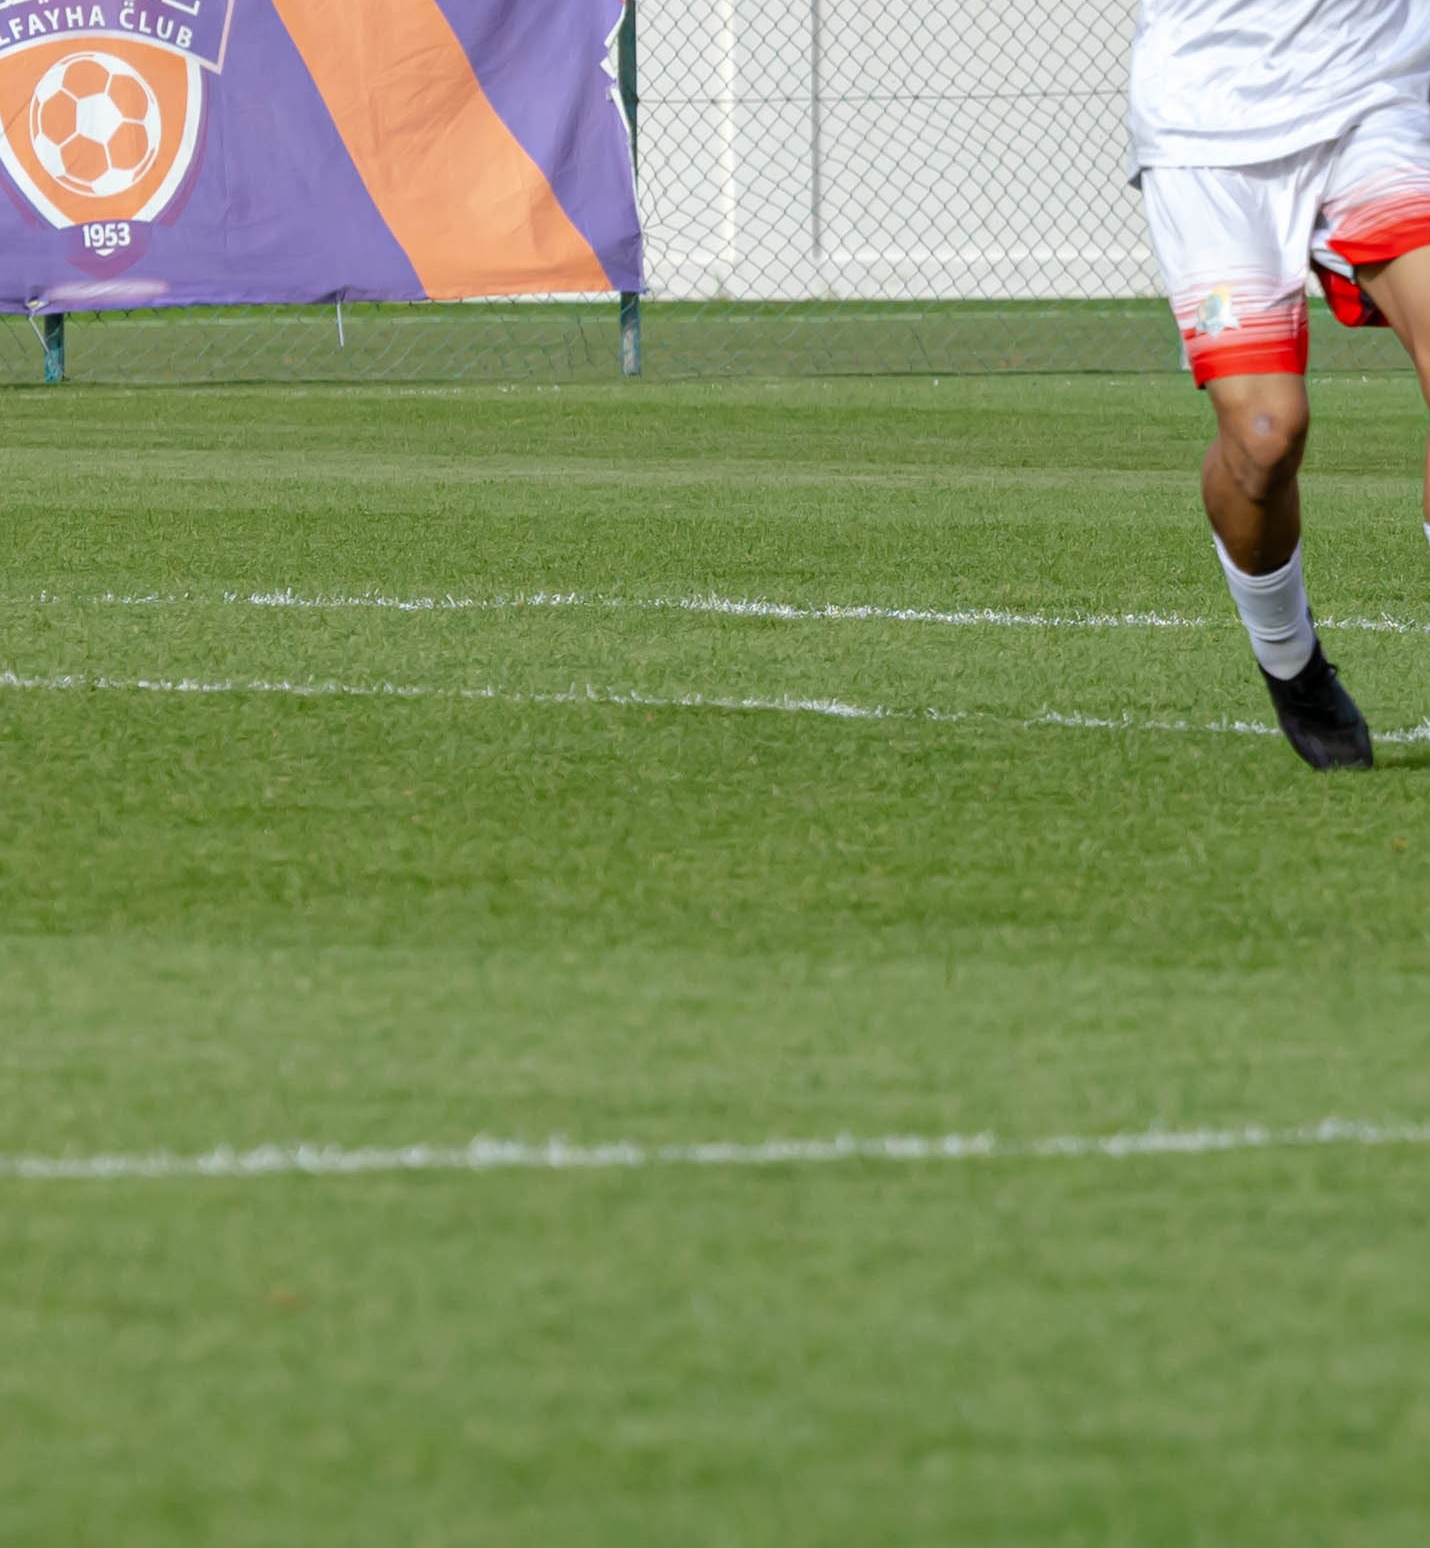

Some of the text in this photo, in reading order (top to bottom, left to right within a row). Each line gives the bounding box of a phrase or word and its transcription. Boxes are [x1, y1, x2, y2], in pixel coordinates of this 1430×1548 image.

[0, 4, 193, 49] FAYHA CLUB
[82, 221, 131, 248] 1953
